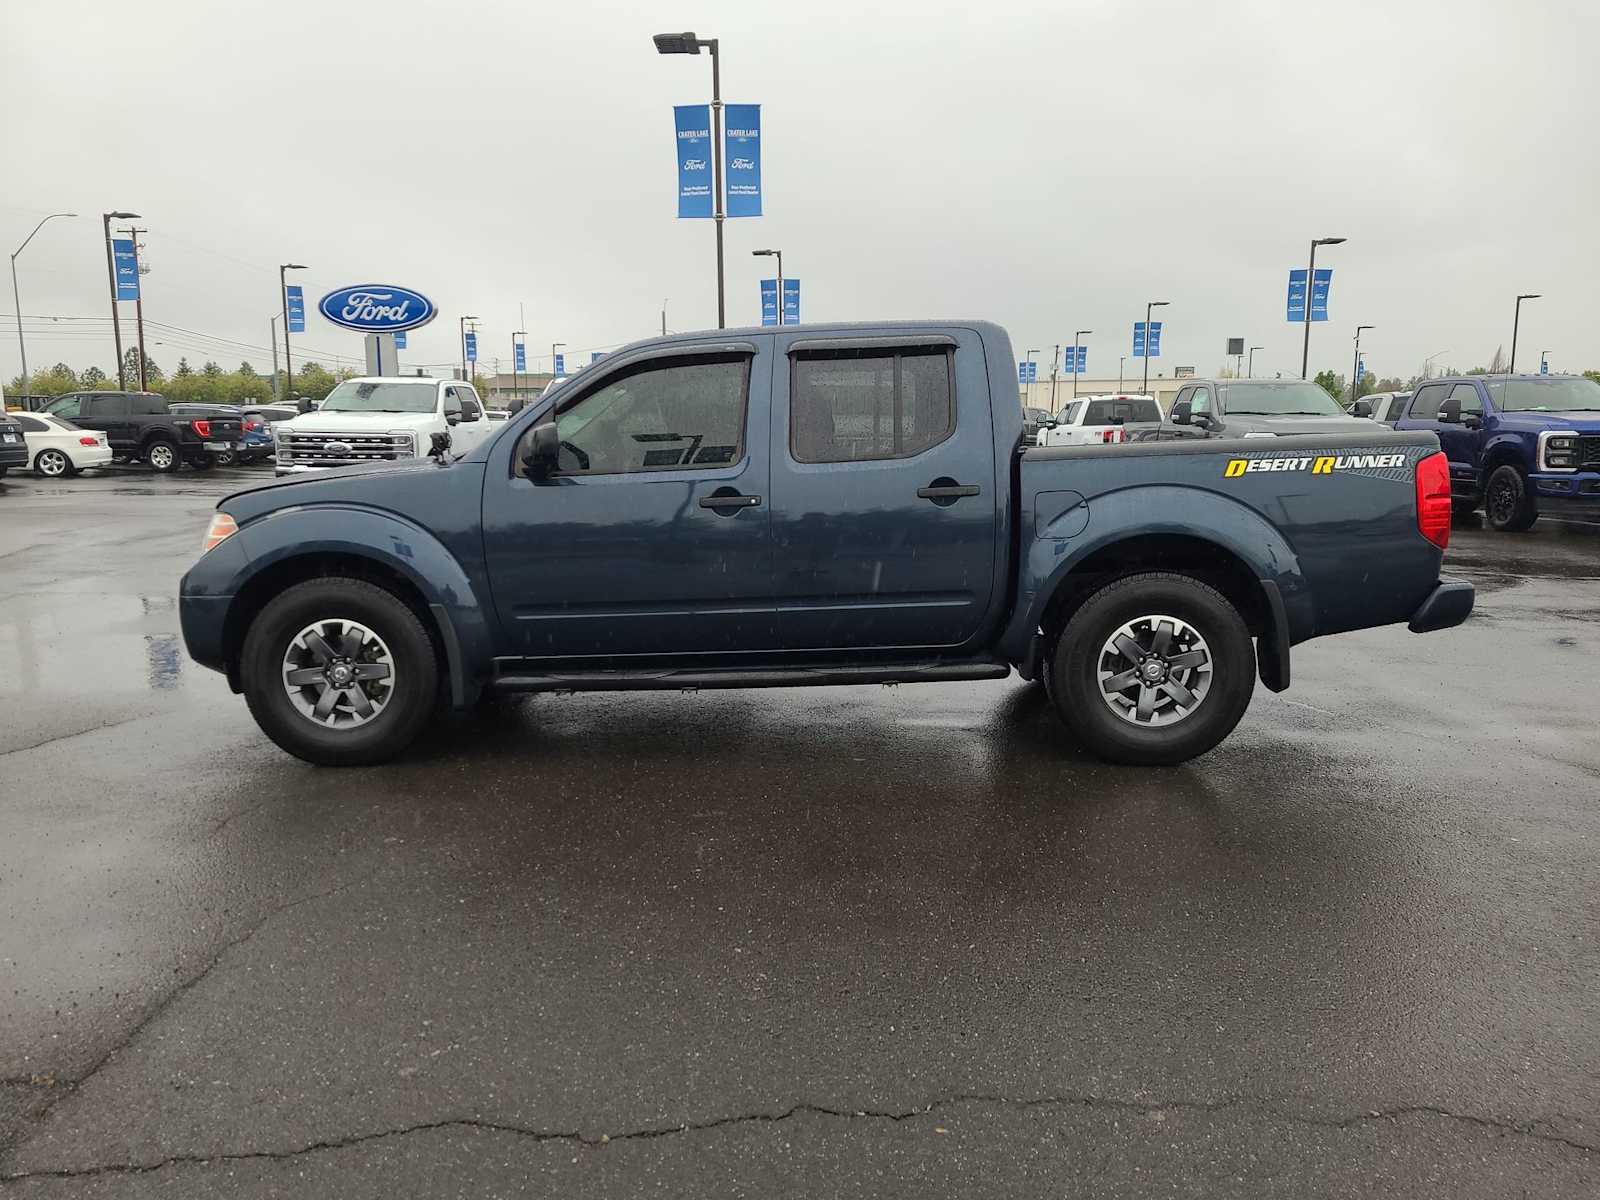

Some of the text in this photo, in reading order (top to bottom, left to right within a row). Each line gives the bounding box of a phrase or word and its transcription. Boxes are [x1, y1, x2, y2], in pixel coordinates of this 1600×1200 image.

[678, 129, 709, 138] CRATER LAKE
[727, 129, 759, 137] CRATER LAKE
[684, 160, 706, 170] Ford
[731, 158, 755, 169] Ford
[342, 292, 410, 321] Ford
[1224, 454, 1406, 478] DESERT RUNNER
